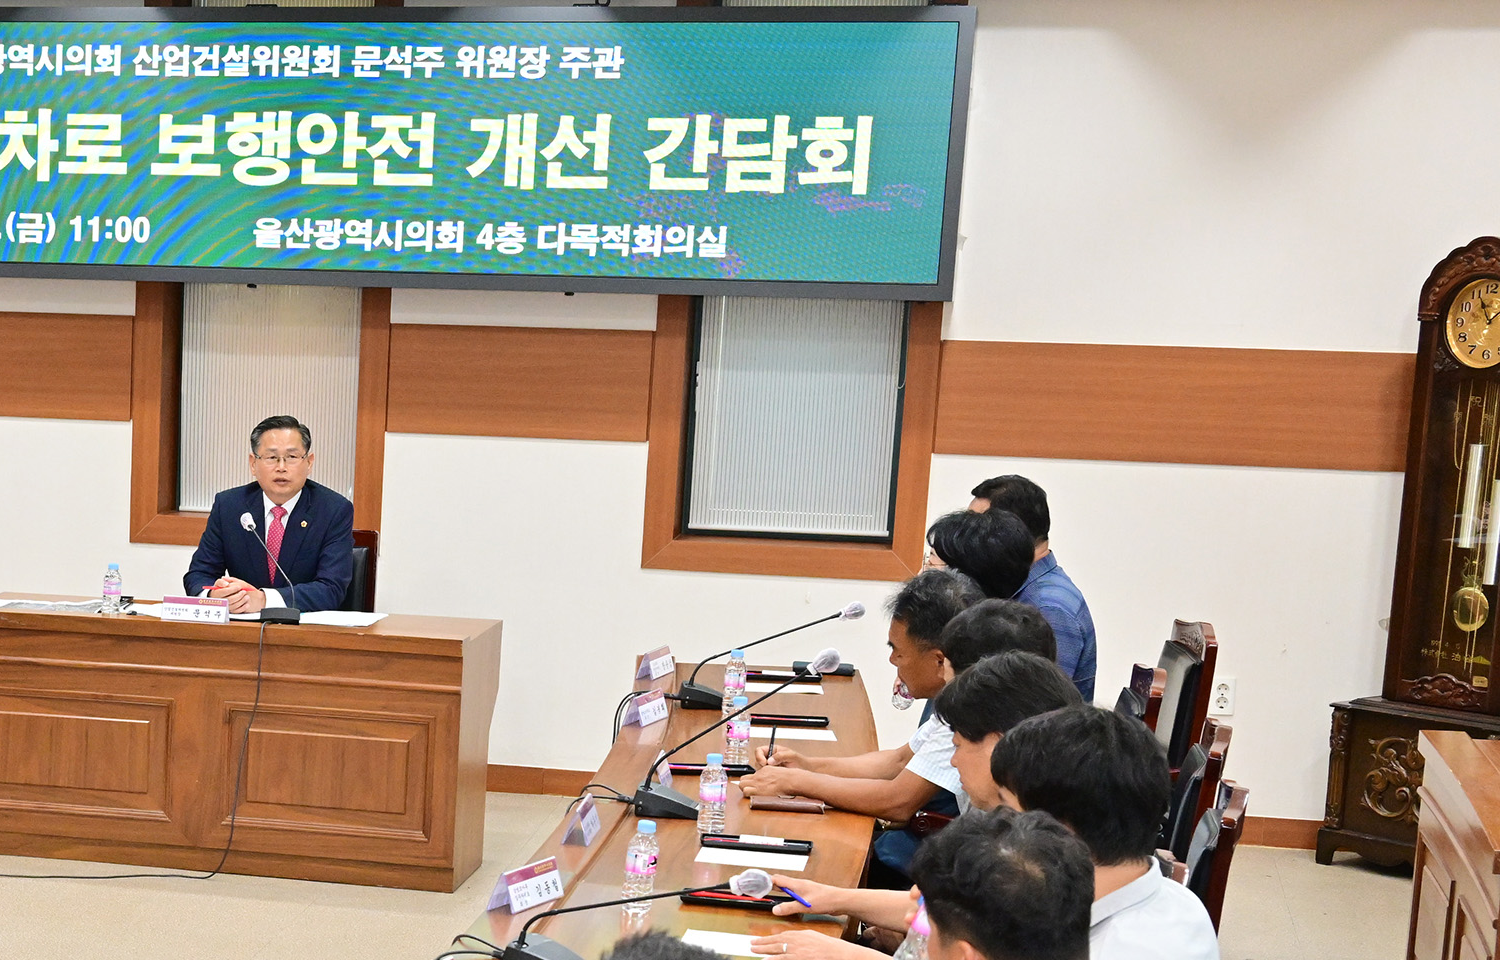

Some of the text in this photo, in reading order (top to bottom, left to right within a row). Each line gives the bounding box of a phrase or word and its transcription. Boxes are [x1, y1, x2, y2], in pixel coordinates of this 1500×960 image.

[133, 45, 340, 78] 산업건설위원회
[352, 45, 445, 78] 문석주
[455, 45, 550, 79] 위원장
[559, 46, 625, 80] 주관
[150, 110, 437, 188] 보행안전
[466, 111, 613, 191] 개선
[643, 114, 874, 196] 간담회
[70, 214, 151, 243] 11:00
[253, 217, 728, 259] 울산광역시의회 4층 다목적회의실
[1461, 302, 1472, 312] 10
[1456, 317, 1464, 327] 9
[1458, 332, 1467, 342] 8
